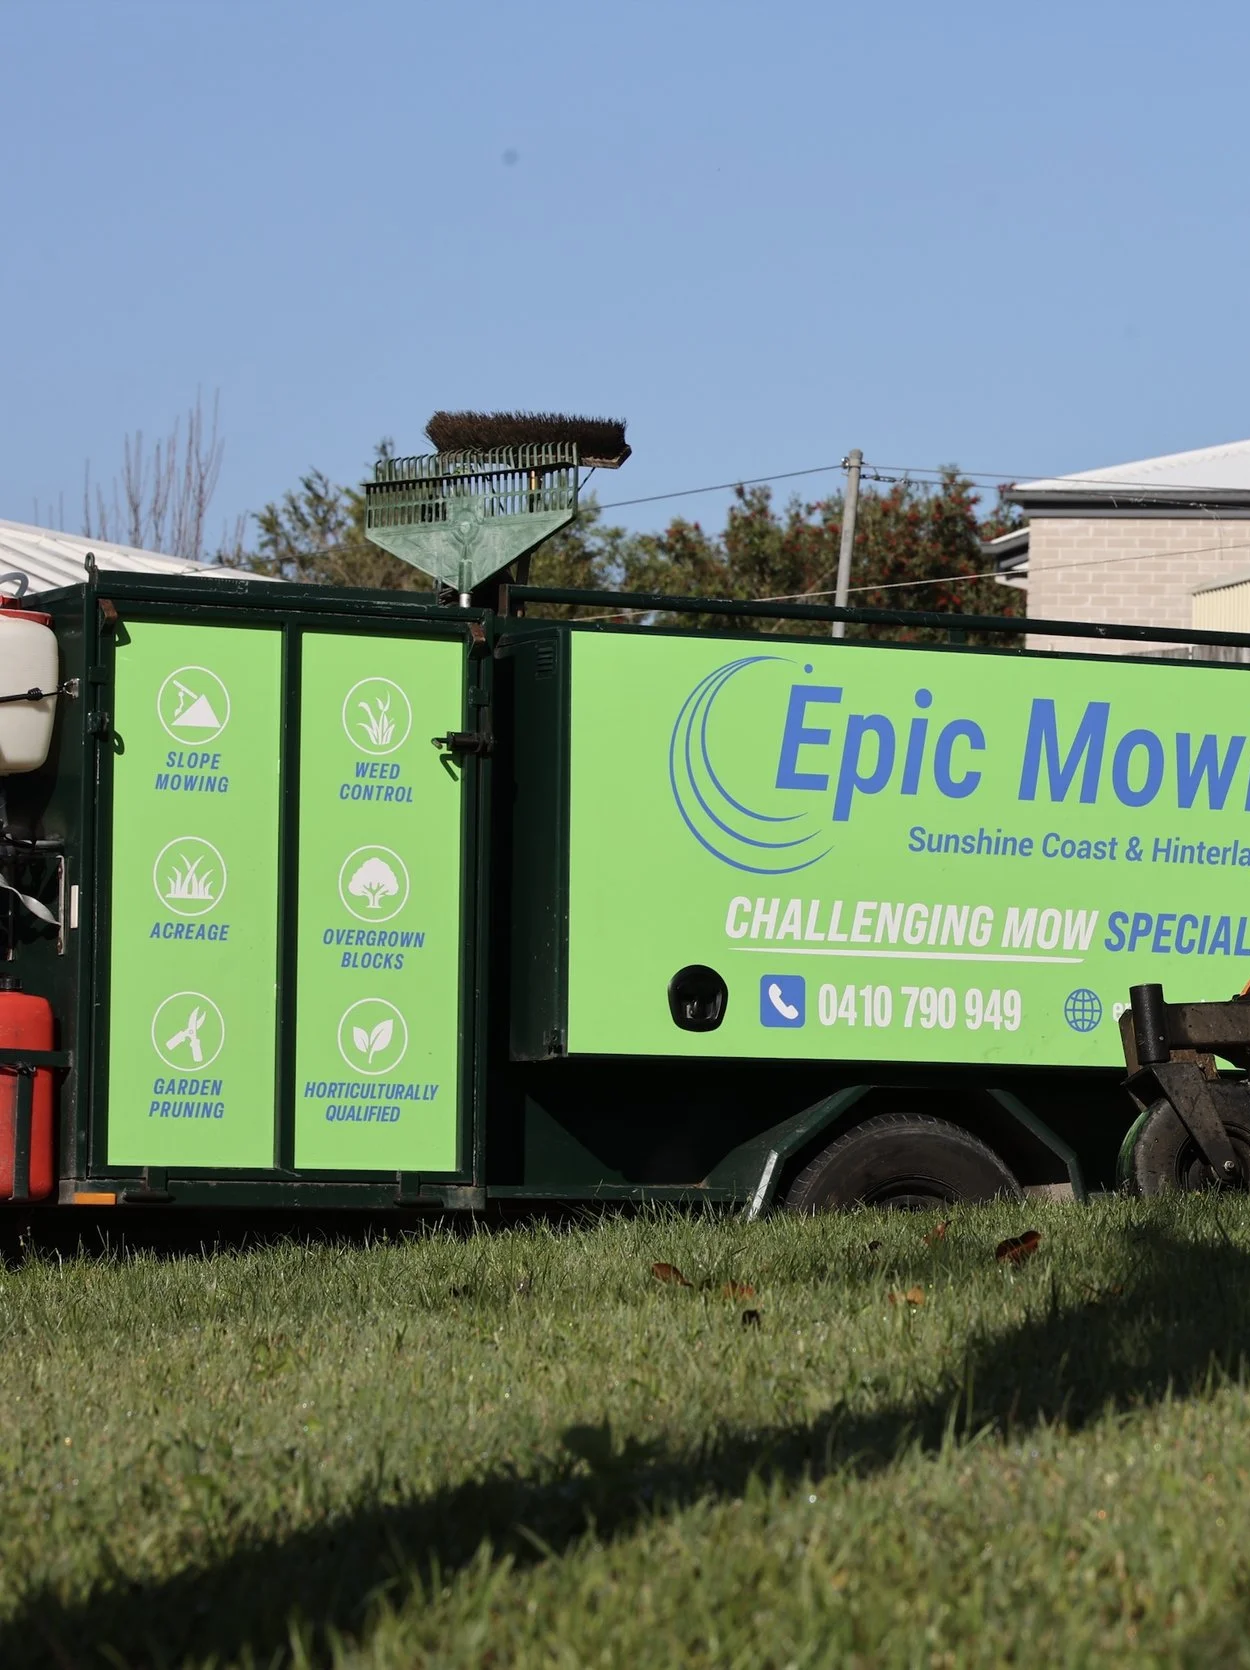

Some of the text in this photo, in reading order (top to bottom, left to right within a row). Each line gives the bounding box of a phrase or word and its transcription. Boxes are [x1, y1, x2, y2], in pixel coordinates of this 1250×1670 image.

[166, 751, 221, 770] SLOPE
[774, 684, 987, 823] Epic
[355, 763, 401, 779] WEED
[155, 774, 229, 793] MOWING
[339, 784, 414, 803] CONTROL
[908, 825, 1034, 857] Sunshine
[1041, 832, 1118, 861] Coast
[1125, 836, 1144, 862] &
[150, 922, 229, 942] ACREAGE
[724, 896, 994, 948] CHALLENGING
[1000, 907, 1100, 951] MOW
[322, 928, 425, 948] OVERGROWN
[341, 951, 404, 970] BLOCKS
[818, 983, 1022, 1032] 0410 790 949
[153, 1078, 223, 1096] GARDEN
[304, 1082, 439, 1101] HORTICULTURALLY
[149, 1100, 225, 1119] PRUNING
[325, 1105, 401, 1123] QUALIFIED
